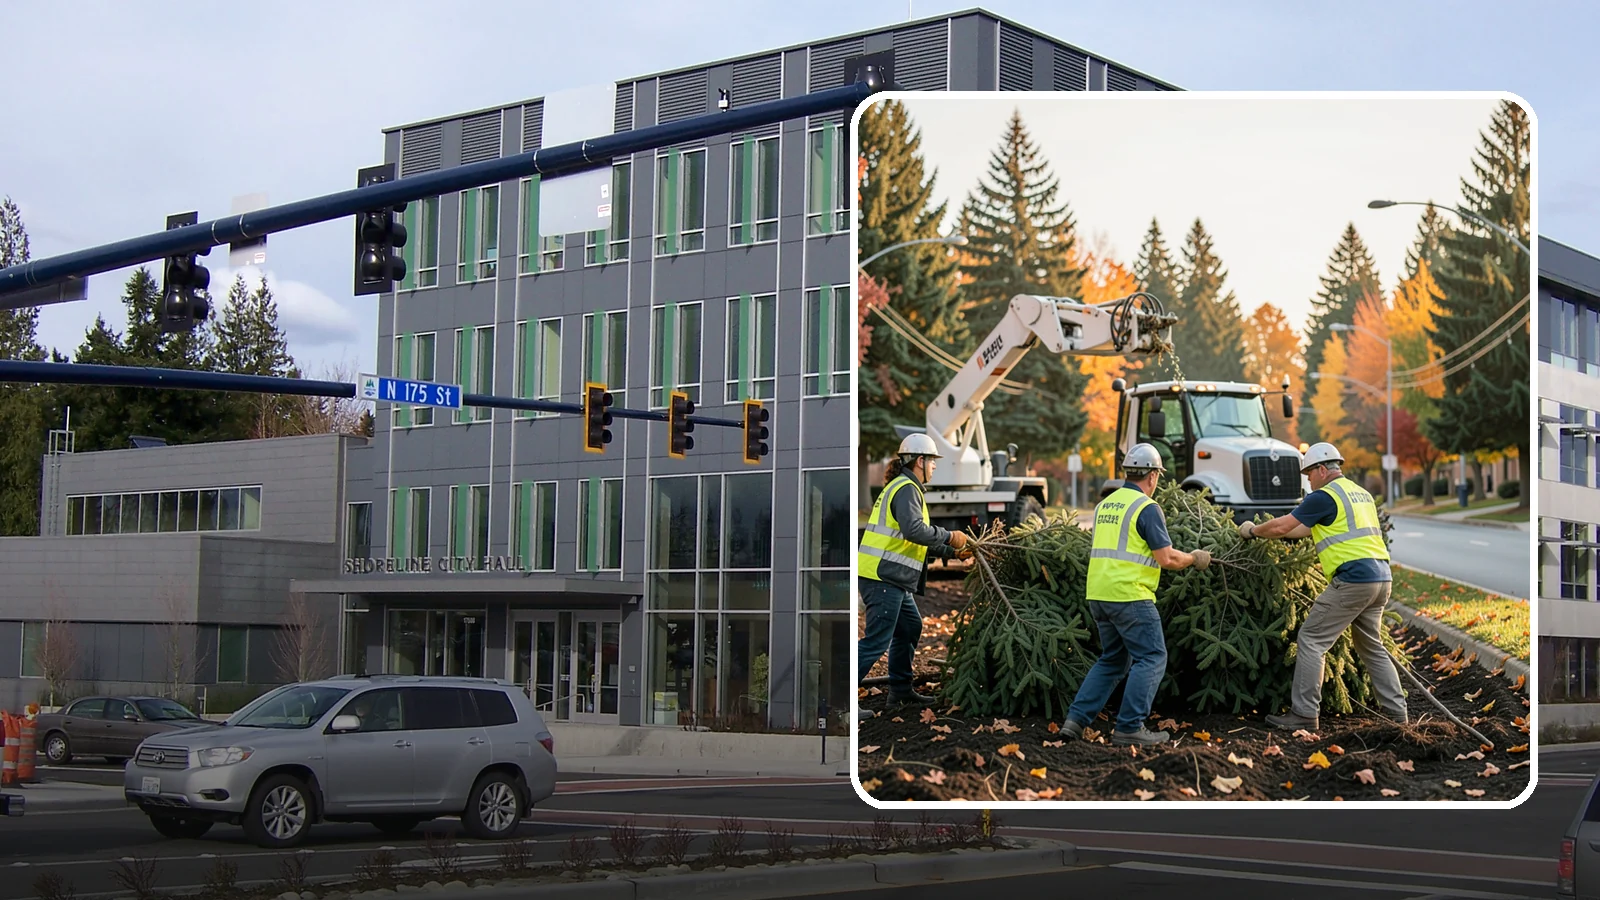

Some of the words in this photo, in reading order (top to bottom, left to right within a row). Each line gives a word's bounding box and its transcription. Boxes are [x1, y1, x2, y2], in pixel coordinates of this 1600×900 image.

[387, 380, 396, 399] N
[405, 382, 427, 403] 175
[436, 386, 451, 406] St
[343, 556, 431, 574] SHORELINE
[438, 556, 475, 573] CITY
[484, 555, 525, 572] HALL
